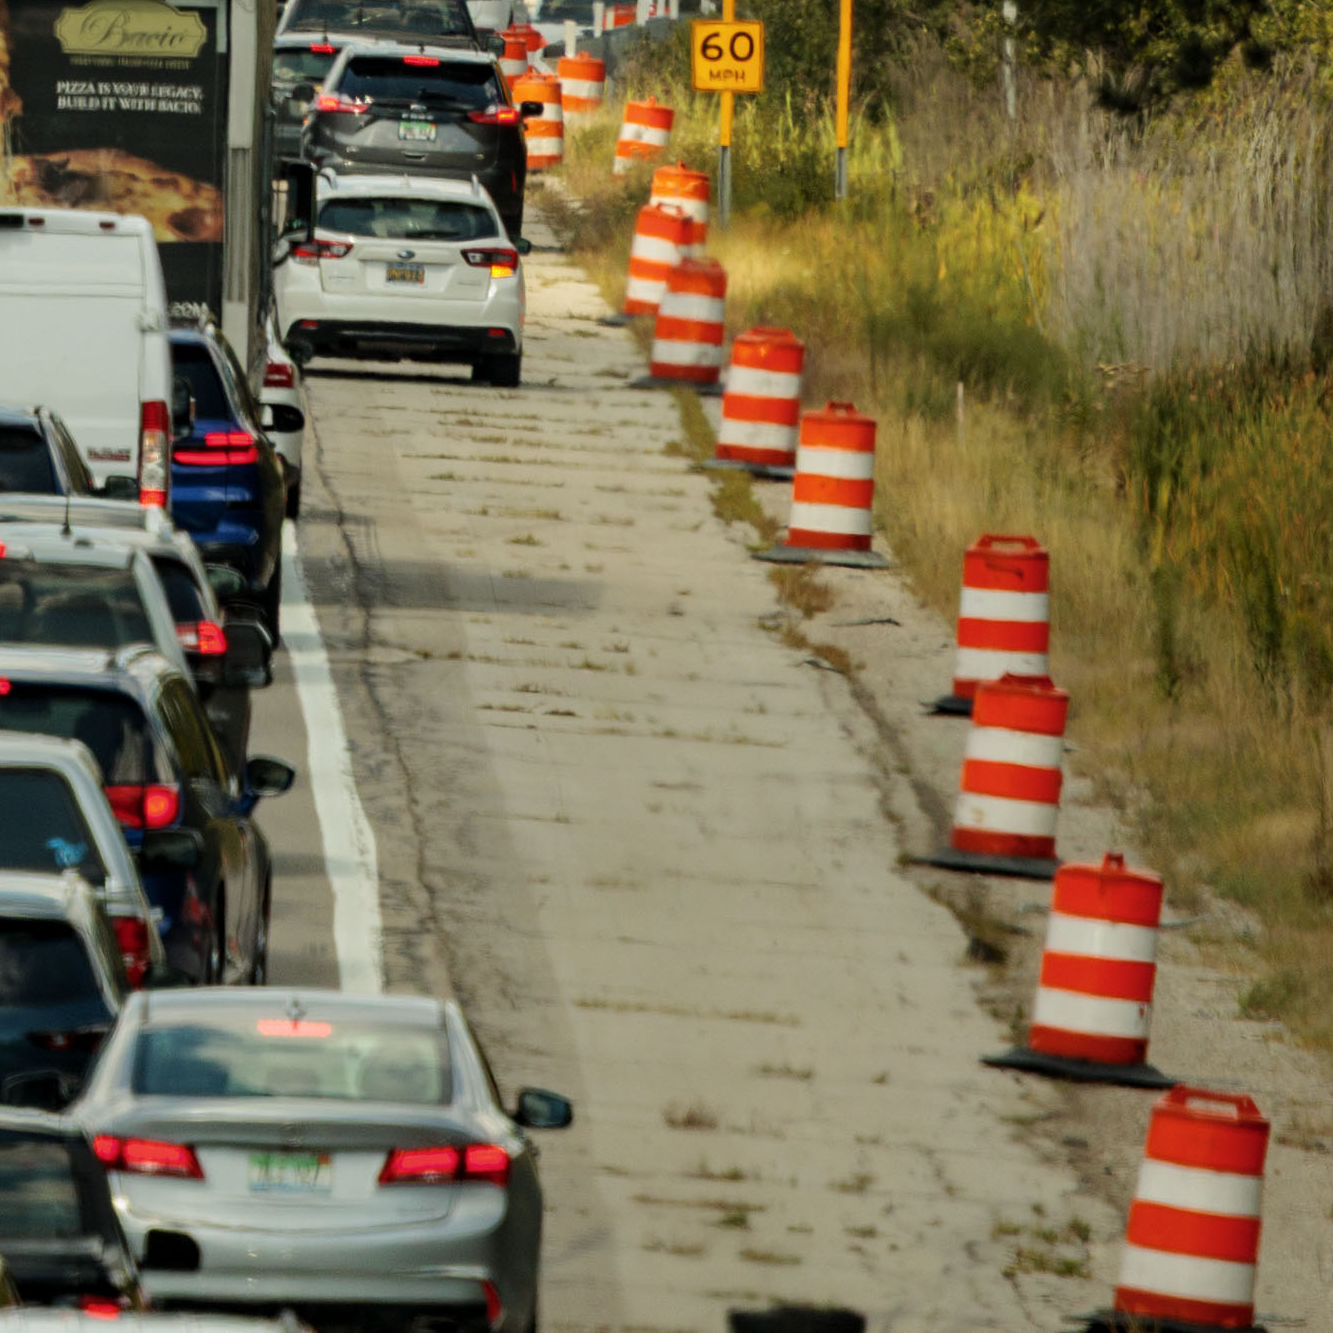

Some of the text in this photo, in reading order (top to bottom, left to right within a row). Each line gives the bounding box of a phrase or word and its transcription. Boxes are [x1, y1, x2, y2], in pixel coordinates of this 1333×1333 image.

[701, 32, 754, 62] 60
[709, 69, 745, 82] MPH
[56, 81, 96, 95] PIZZA
[98, 82, 111, 95] IS
[57, 96, 99, 111] BUILD
[101, 97, 116, 110] IT
[118, 98, 157, 112] WITH
